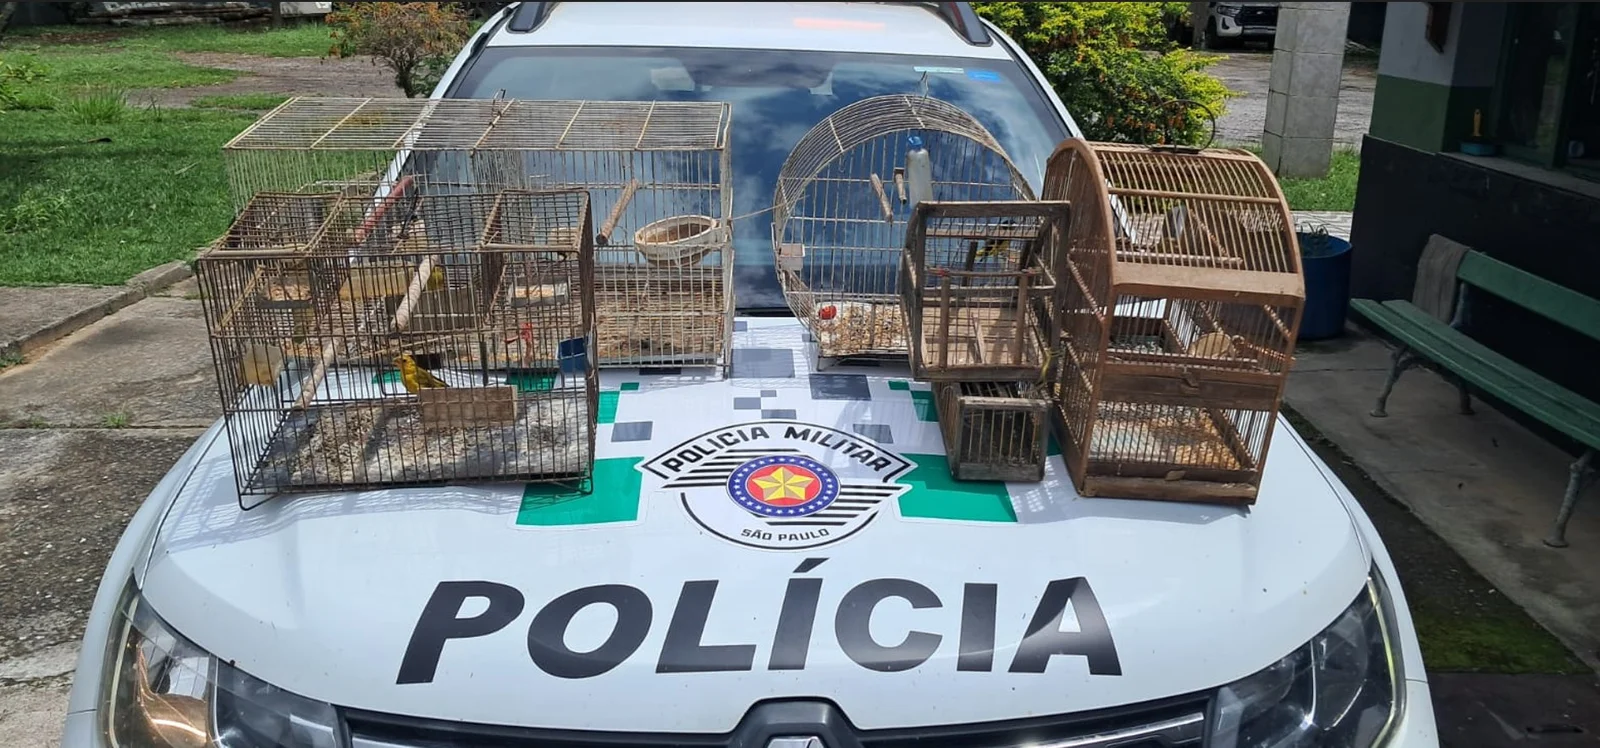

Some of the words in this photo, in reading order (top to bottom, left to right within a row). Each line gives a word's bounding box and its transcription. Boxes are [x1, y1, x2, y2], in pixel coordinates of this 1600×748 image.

[661, 427, 770, 472] POLICIA
[784, 426, 892, 472] MILITAR
[741, 528, 772, 541] SÃO
[778, 528, 830, 541] PAULO
[396, 557, 1123, 684] POLÍCIA
